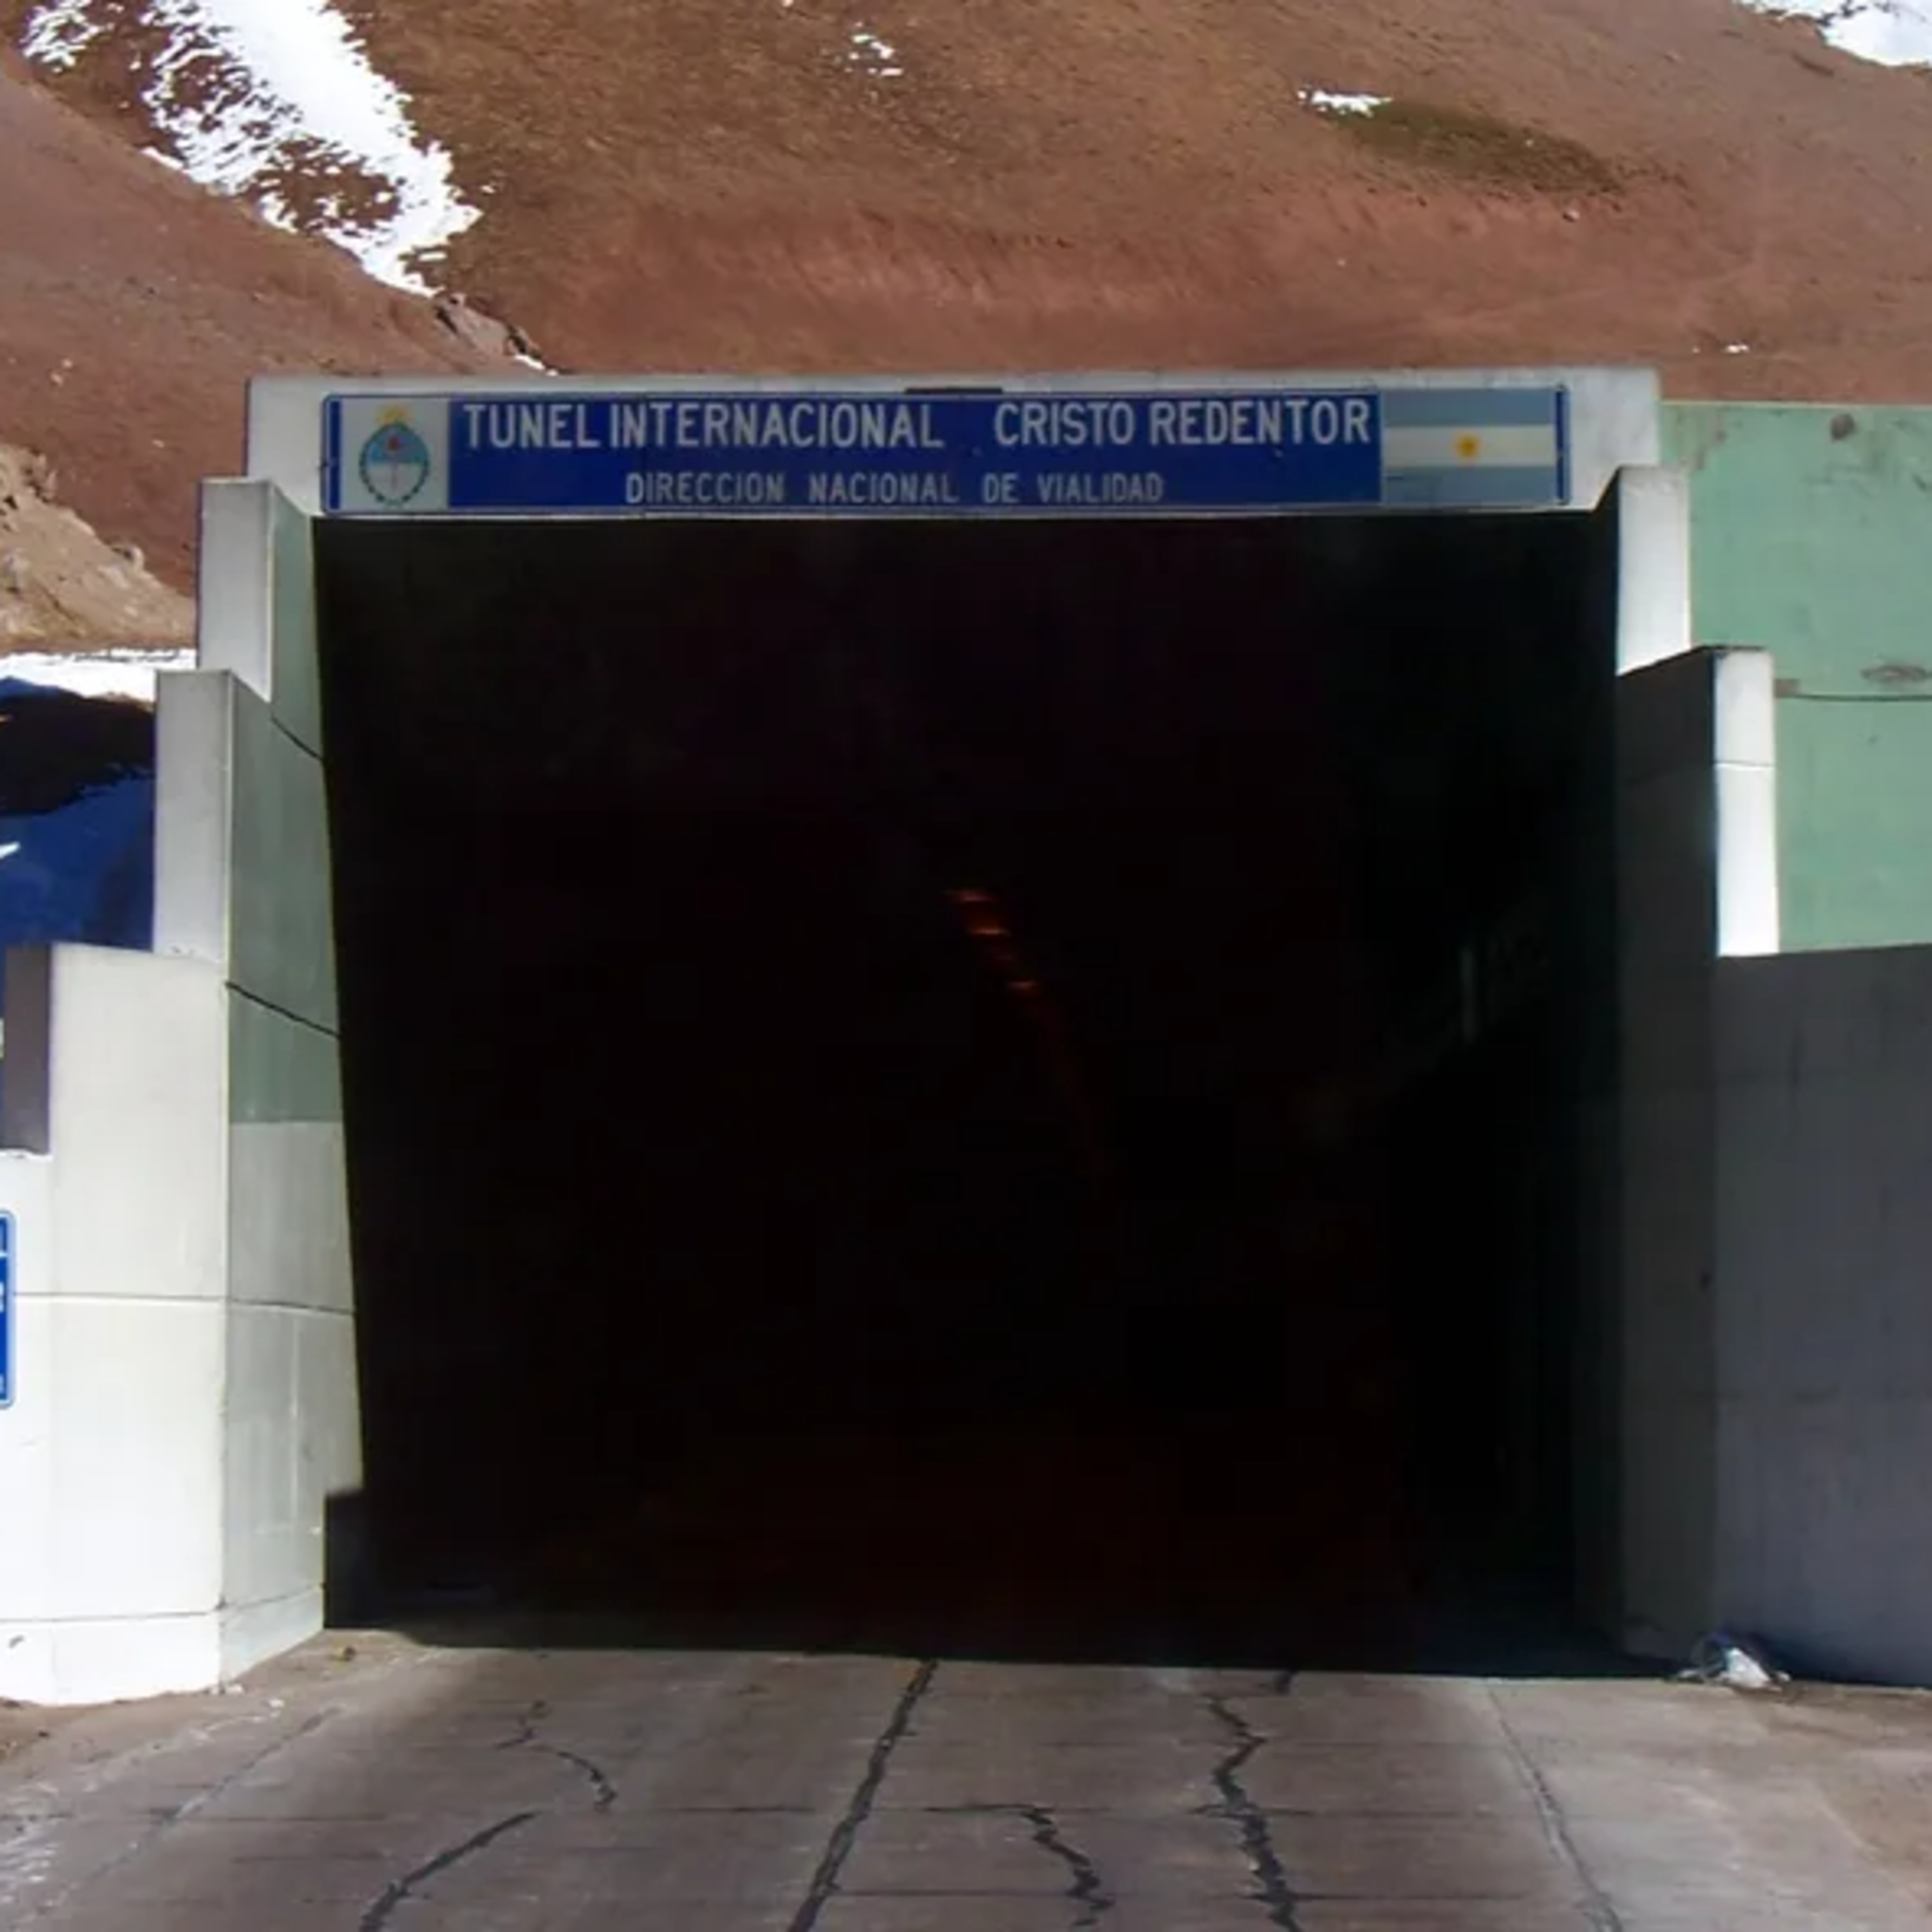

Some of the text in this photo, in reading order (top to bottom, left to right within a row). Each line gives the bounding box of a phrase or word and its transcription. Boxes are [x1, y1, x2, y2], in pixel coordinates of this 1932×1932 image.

[464, 400, 1370, 448] TUNEL INTERNACIONAL CRISTO REDENTOR
[625, 473, 1164, 504] DIRECCION NACIONAL DE VIALIDAD
